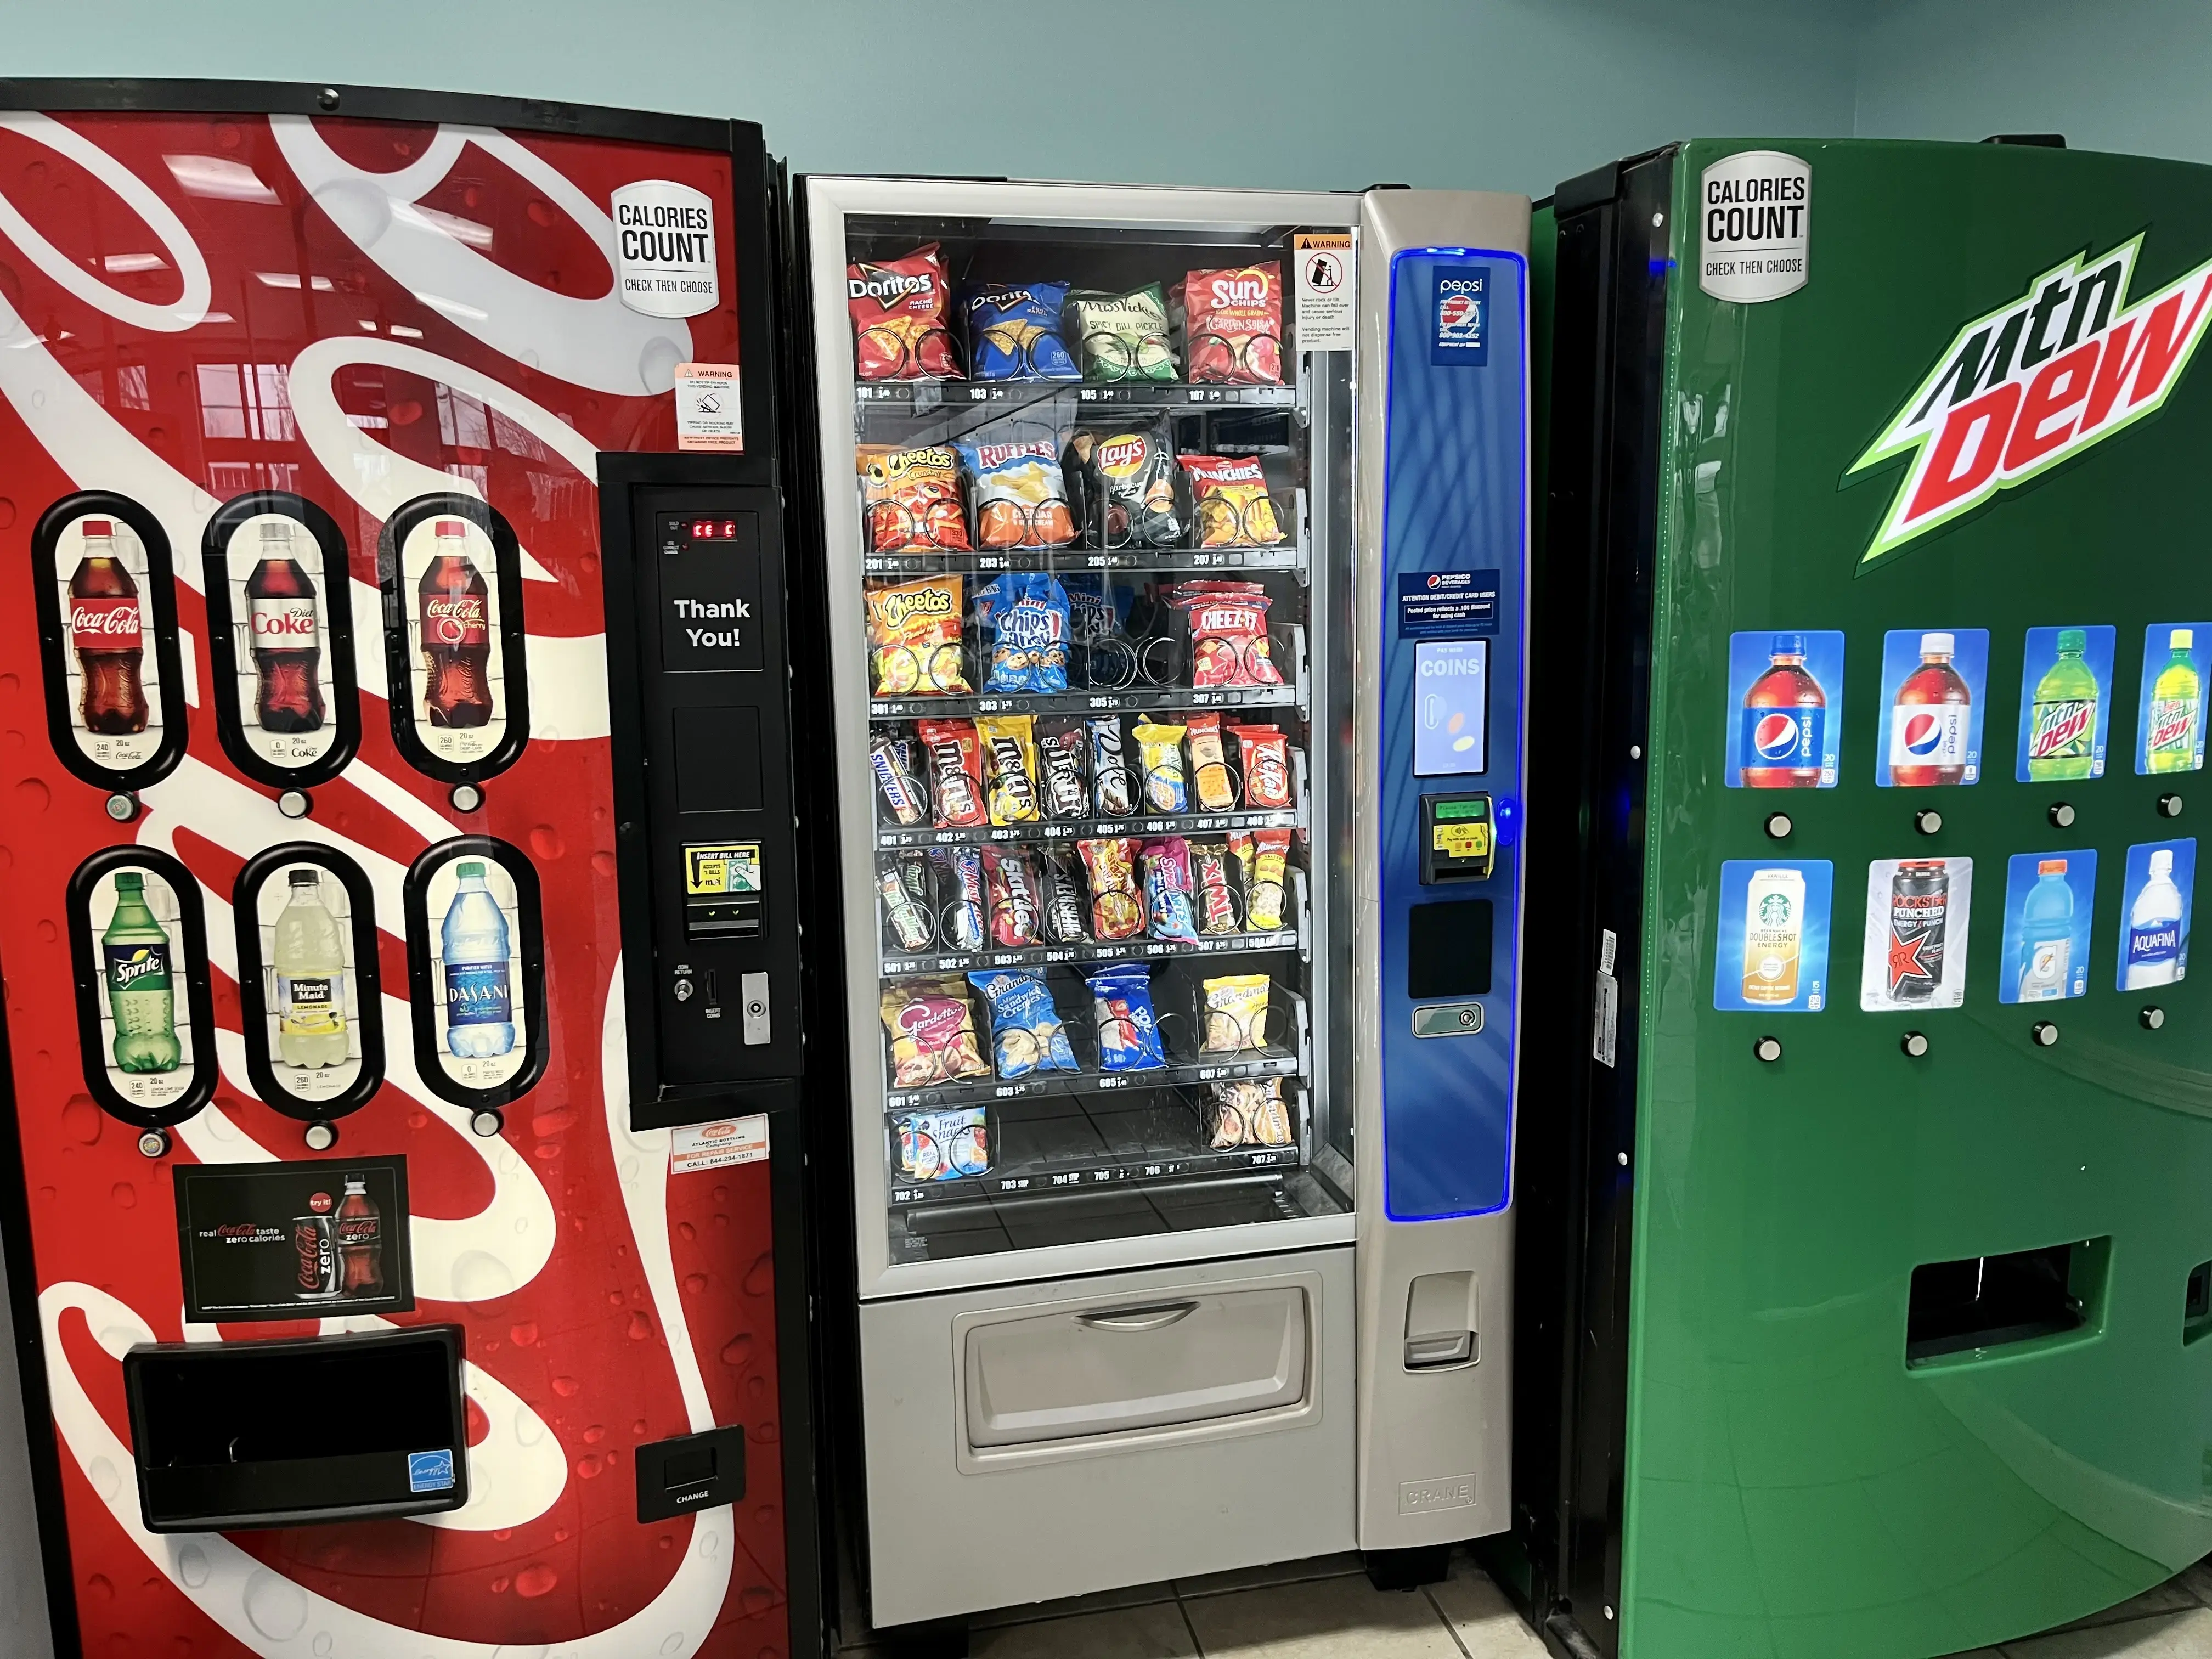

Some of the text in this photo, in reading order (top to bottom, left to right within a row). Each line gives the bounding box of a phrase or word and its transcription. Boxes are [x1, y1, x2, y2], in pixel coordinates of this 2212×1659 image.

[1707, 177, 1805, 205] CALORIES
[619, 204, 708, 229] CALORIES
[1707, 205, 1804, 242] COUNT
[622, 230, 709, 263] COUNT
[1706, 258, 1803, 276] CHECK THEN CHOOSE
[625, 279, 713, 294] CHECK THEN CHOOSE
[849, 274, 932, 299] Doritos
[1440, 278, 1483, 294] pepsi
[1231, 299, 1266, 308] CHIPS
[1090, 320, 1163, 331] SPICY DILL PICKLE
[856, 387, 872, 398] 101
[970, 388, 986, 399] 103
[1081, 390, 1096, 400] 105
[1189, 390, 1204, 400] 107
[978, 441, 1056, 470] RUFFLES
[1099, 439, 1143, 466] Lay's
[888, 446, 953, 481] Cheetos
[1189, 464, 1263, 482] MUNCHIES
[866, 559, 882, 569] 201
[980, 558, 997, 568] 203
[1088, 556, 1105, 566] 205
[1194, 555, 1209, 565] 207
[290, 607, 313, 618] Diet
[427, 599, 482, 619] Coca-Cola
[674, 599, 751, 618] Thank
[885, 588, 952, 630] Cheetos
[72, 606, 139, 635] Coca-Cola
[251, 612, 314, 634] Coke
[463, 622, 486, 630] cherry
[1000, 609, 1050, 634] Chips
[686, 628, 740, 647] You!
[1421, 658, 1480, 677] COINS
[1090, 697, 1107, 707] 305
[1193, 694, 1209, 703] 307
[871, 704, 888, 714] 301
[980, 701, 997, 711] 303
[1801, 715, 1813, 757] pepsi
[1948, 715, 1957, 754] pepsi
[1147, 821, 1163, 831] 406
[1197, 819, 1212, 828] 407
[991, 830, 1008, 839] 403
[1045, 827, 1061, 837] 404
[1097, 825, 1113, 834] 405
[880, 836, 896, 845] 401
[936, 832, 953, 842] 402
[696, 851, 719, 860] INSERT
[1001, 857, 1026, 938] Skittles
[1894, 907, 1944, 918] PUNCHED
[1893, 917, 1943, 928] ENERGY PUNCH
[1750, 933, 1797, 942] DOUBLESHOT
[2132, 930, 2176, 953] AQUAFINA
[1147, 944, 1163, 954] 506
[1197, 941, 1214, 951] 507
[1047, 952, 1063, 961] 504
[1097, 948, 1113, 958] 505
[939, 958, 957, 969] 502
[995, 955, 1012, 964] 503
[117, 955, 160, 983] Sprite
[884, 963, 901, 973] 501
[294, 983, 329, 992] Minute
[449, 982, 509, 1004] DASANI
[298, 991, 325, 1000] Maid
[1200, 1069, 1215, 1079] 607
[1100, 1078, 1116, 1087] 605
[996, 1087, 1013, 1096] 603
[889, 1097, 905, 1107] 601
[939, 1114, 967, 1131] Fruit
[692, 1139, 718, 1147] ATLANTIC
[701, 1148, 725, 1157] REPAIR
[726, 1144, 753, 1153] SERVICE
[687, 1159, 708, 1168] CALL:
[1252, 1155, 1265, 1164] 707
[1001, 1179, 1029, 1189] 703 STOP
[1053, 1173, 1080, 1184] 704 STOP
[895, 1191, 910, 1201] 702
[309, 1198, 331, 1207] try it!
[199, 1223, 280, 1238] real Coca-Cola taste
[338, 1220, 377, 1234] Coca-Cola
[226, 1234, 285, 1244] zero calories
[346, 1232, 369, 1241] zero
[295, 1223, 320, 1289] Coca-Cola
[319, 1238, 331, 1275] zero
[675, 1489, 709, 1504] CHANGE
[1406, 1484, 1469, 1505] CRANE
